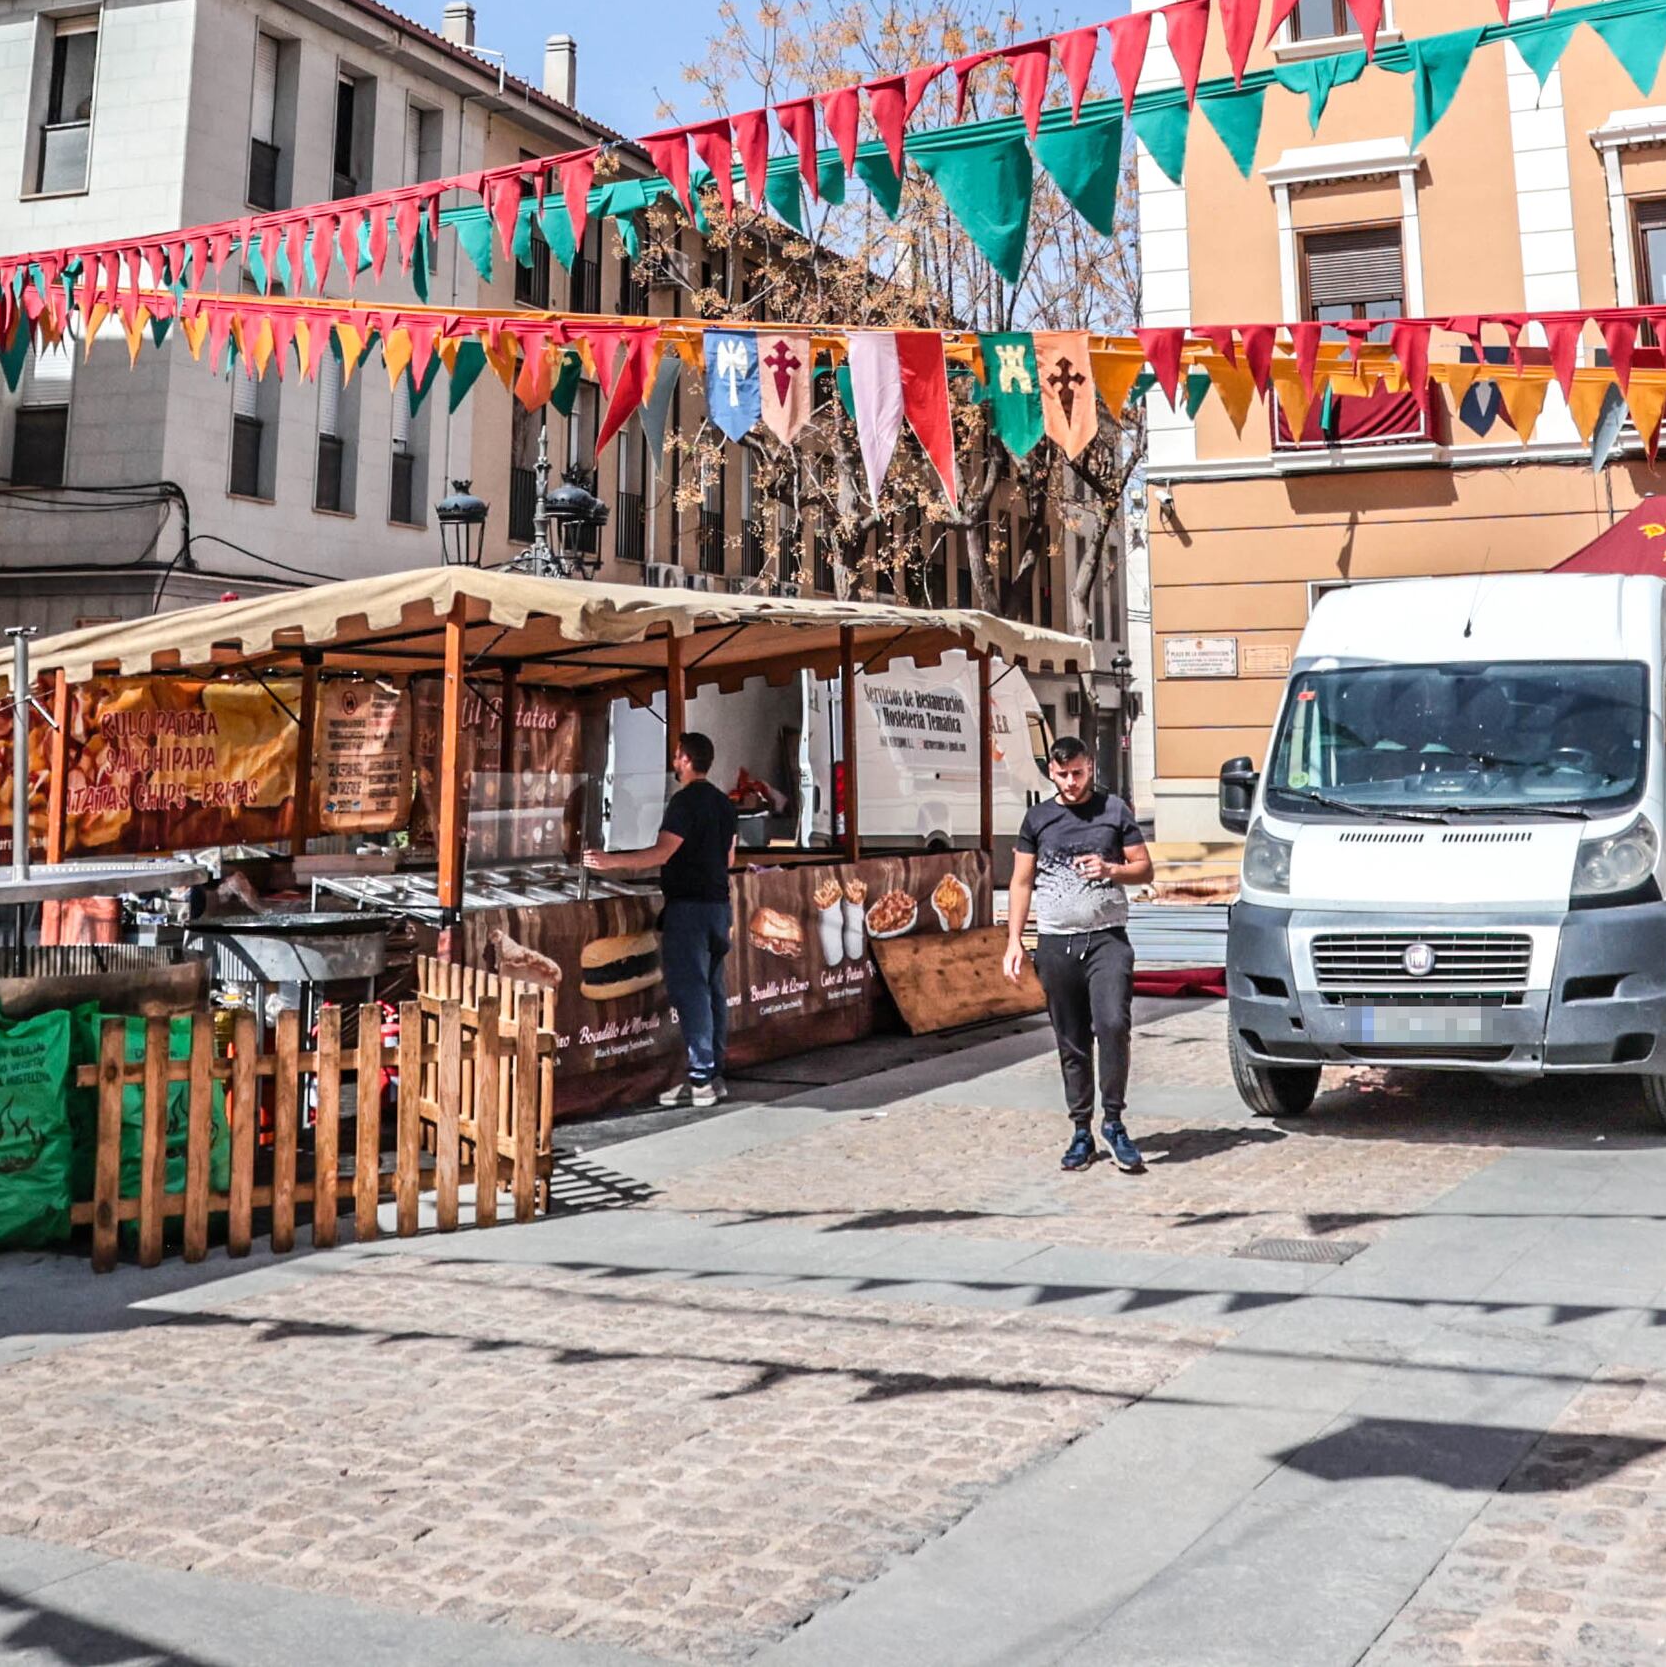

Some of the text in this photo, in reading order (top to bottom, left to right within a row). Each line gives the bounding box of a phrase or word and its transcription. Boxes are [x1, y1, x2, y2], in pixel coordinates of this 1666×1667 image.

[486, 697, 557, 730] Ptatas
[863, 683, 966, 714] Servicios de Restauración
[101, 709, 219, 737] RULO PATATA
[105, 746, 216, 776] SALCHIPAPA
[134, 782, 186, 812] CHIPS
